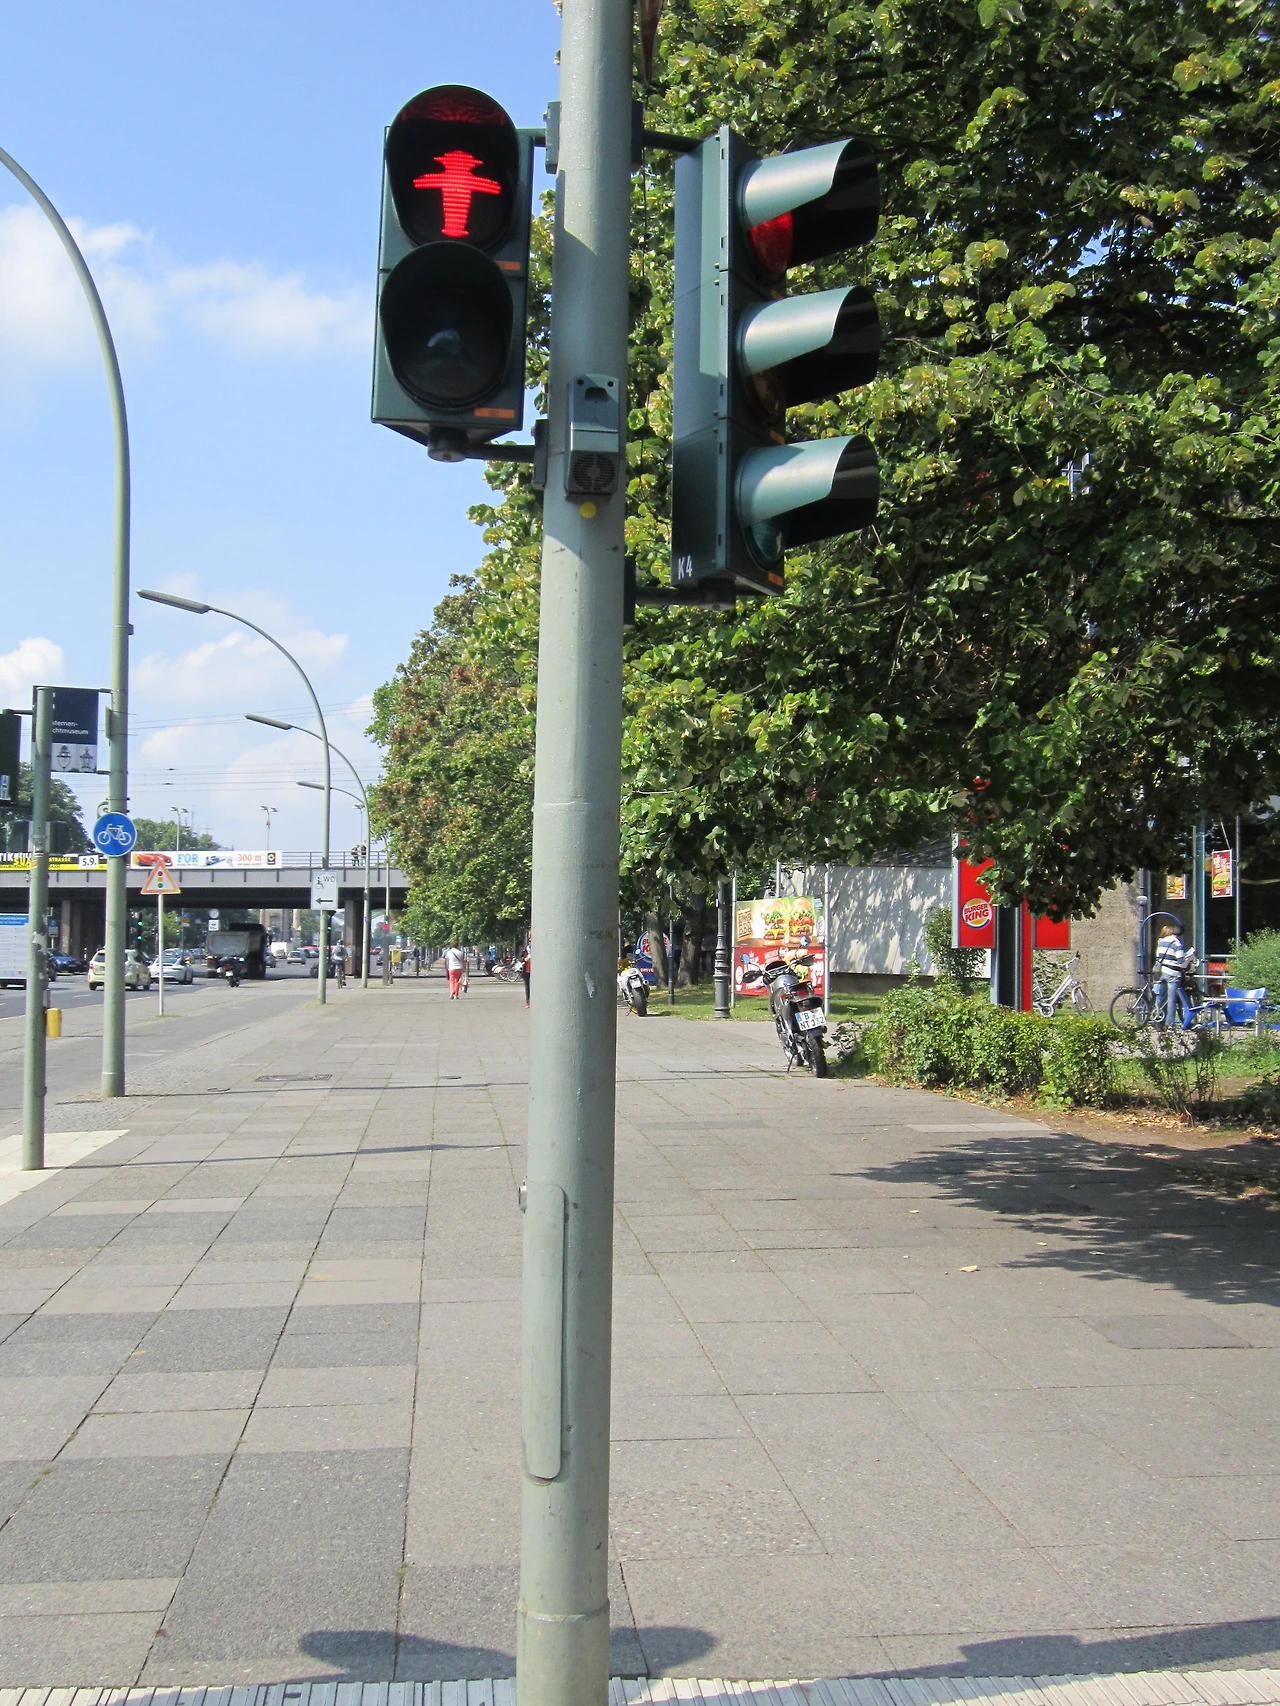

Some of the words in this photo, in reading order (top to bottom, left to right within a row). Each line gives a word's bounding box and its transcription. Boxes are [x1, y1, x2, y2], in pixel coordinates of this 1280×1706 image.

[678, 555, 692, 580] K4
[82, 857, 97, 867] 5.9.
[177, 853, 199, 863] FOR
[238, 854, 253, 862] 300
[964, 904, 988, 915] BURGER
[965, 909, 989, 922] KING
[803, 1012, 810, 1020] B
